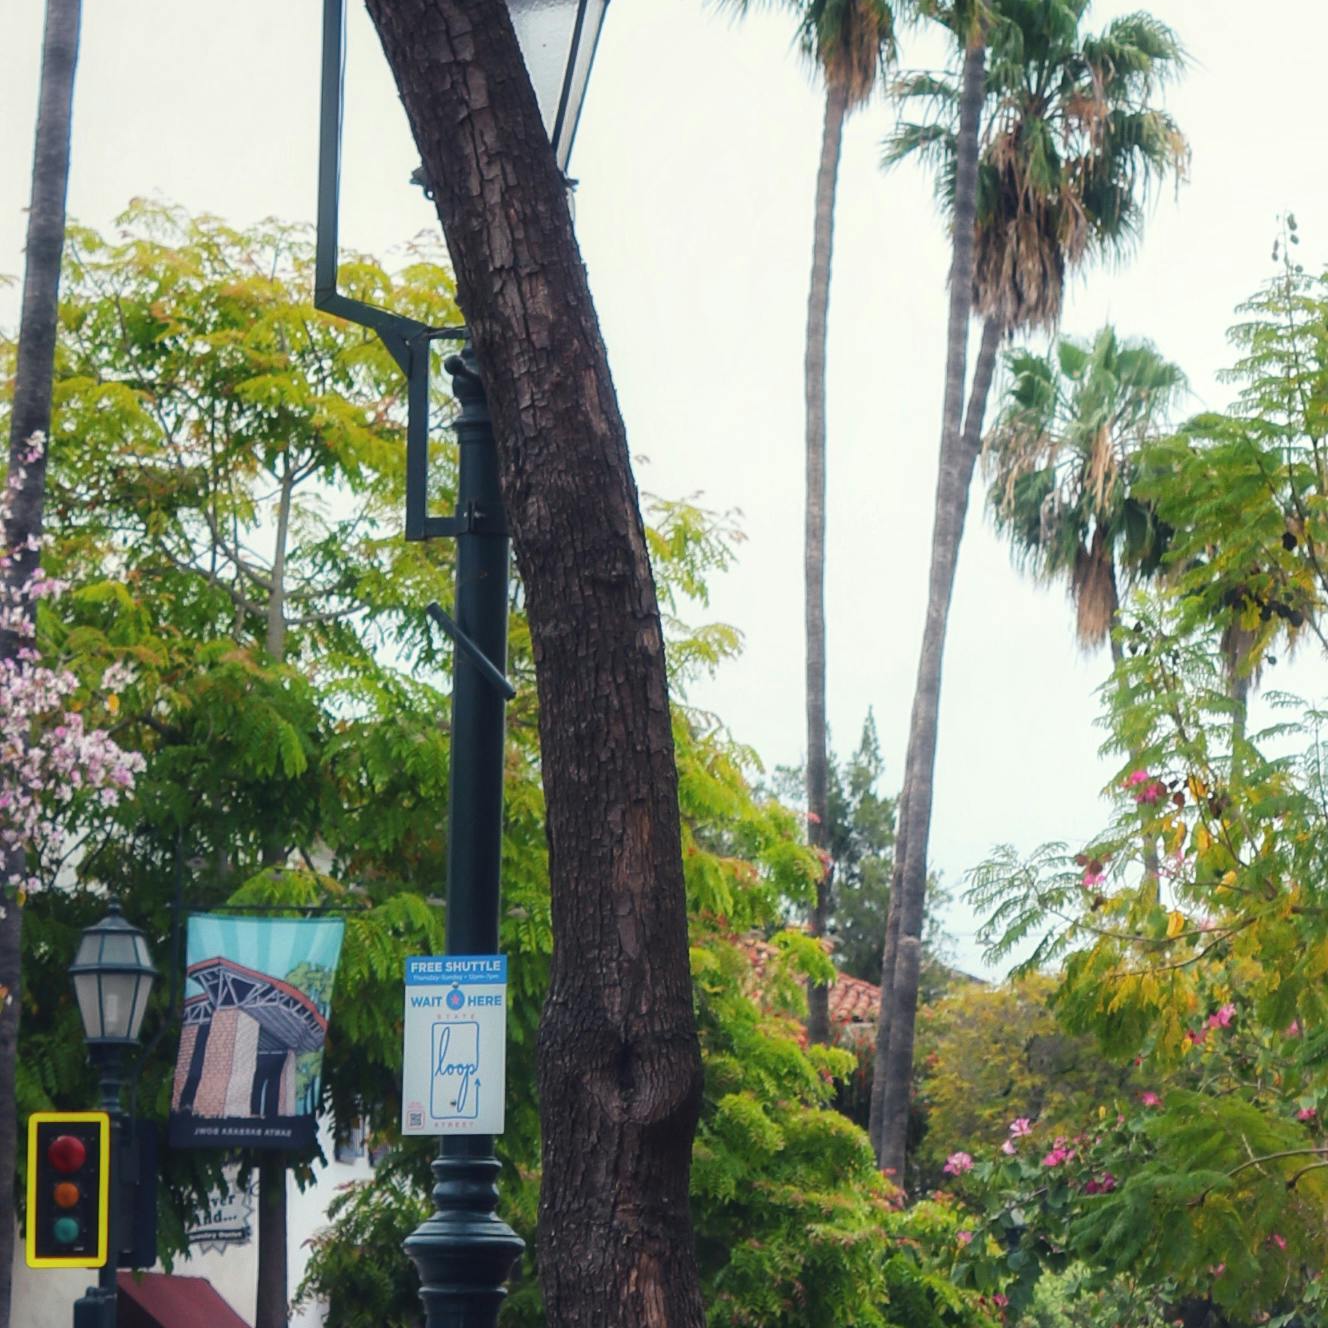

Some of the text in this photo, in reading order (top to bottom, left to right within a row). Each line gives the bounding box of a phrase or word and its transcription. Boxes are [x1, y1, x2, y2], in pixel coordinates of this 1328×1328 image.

[411, 960, 501, 973] FREE SHUTTLE
[411, 995, 502, 1007] WAIT HERE
[435, 1026, 477, 1112] loop
